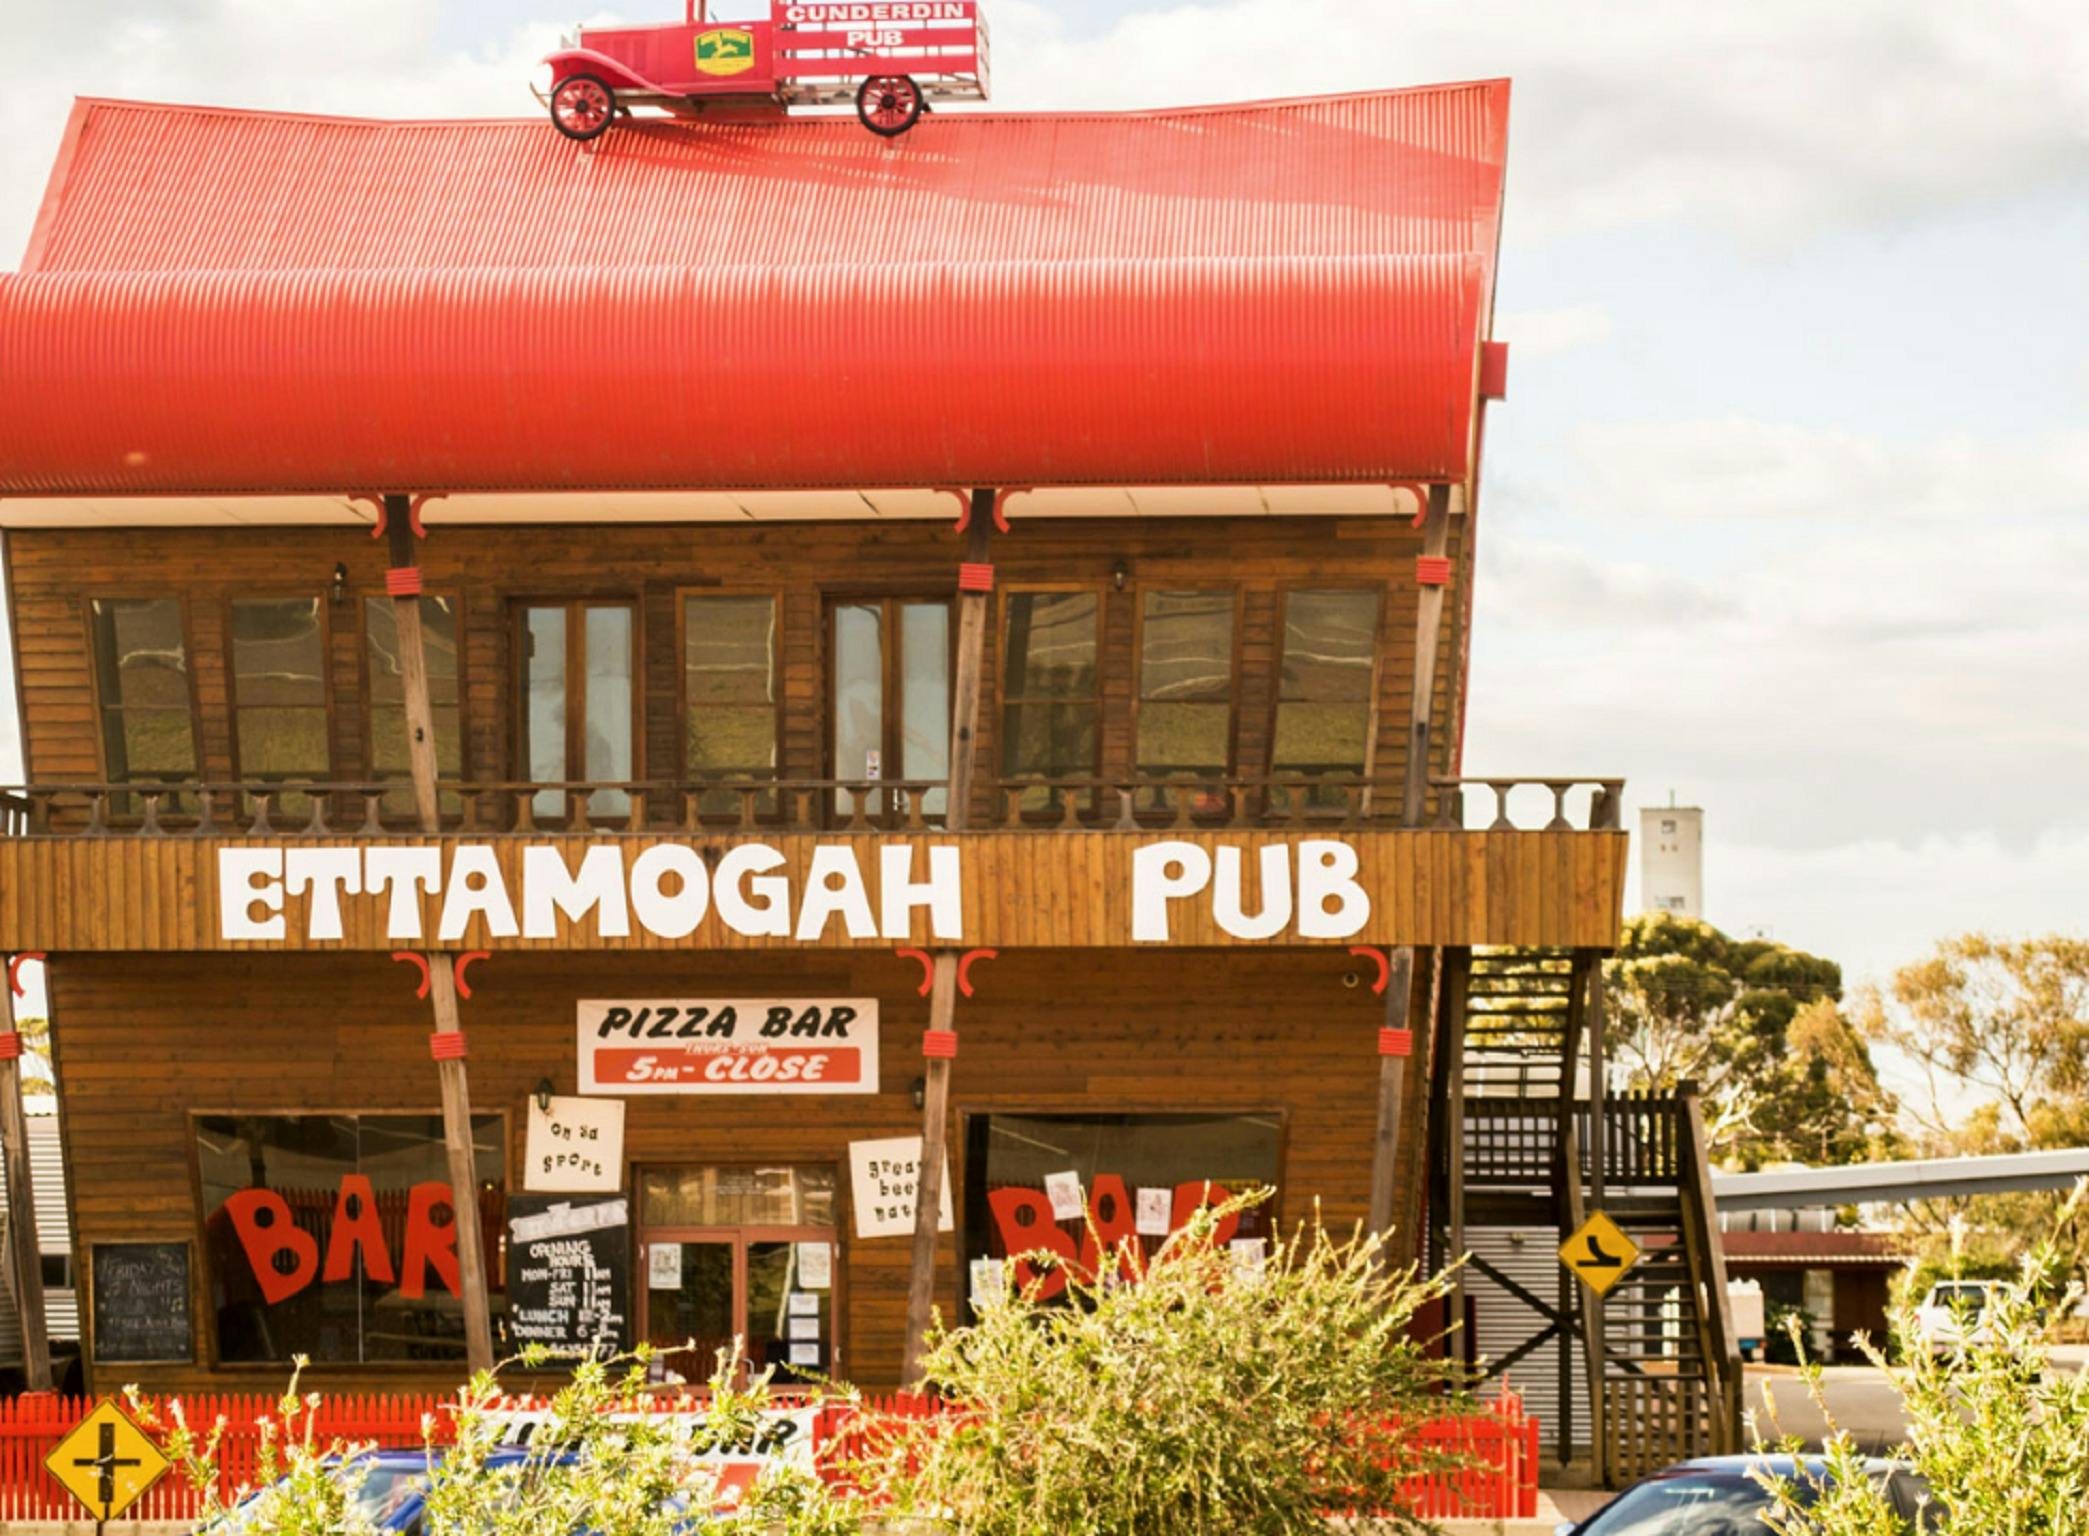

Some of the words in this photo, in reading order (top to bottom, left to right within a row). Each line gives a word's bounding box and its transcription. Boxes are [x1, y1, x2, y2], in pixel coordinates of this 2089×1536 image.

[786, 3, 964, 22] CUNDERDIN
[847, 30, 904, 47] PUB
[218, 843, 962, 940] ETTAMOGAH
[1132, 839, 1371, 941] PUB
[597, 1005, 737, 1039] PIZZA
[759, 1005, 857, 1039] BAR
[704, 1055, 830, 1083] CLOSE
[879, 1179, 919, 1197] bee
[224, 1174, 463, 1306] BAR
